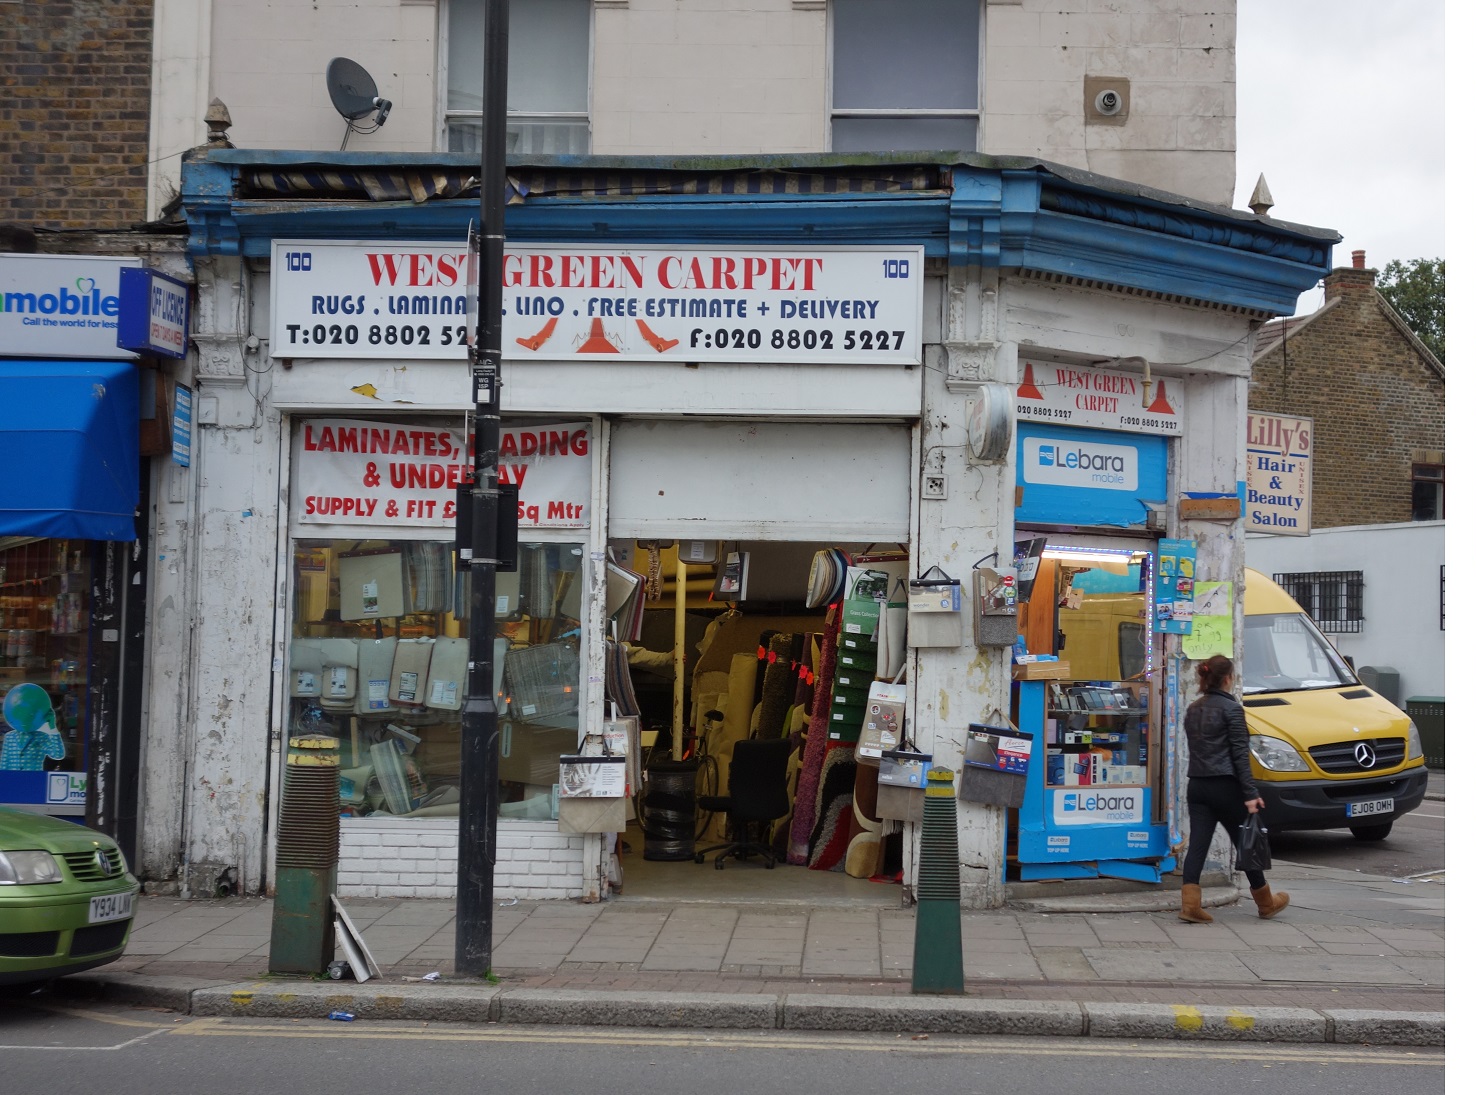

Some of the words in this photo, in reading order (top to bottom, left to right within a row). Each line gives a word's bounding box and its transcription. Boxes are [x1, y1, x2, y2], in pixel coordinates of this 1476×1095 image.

[285, 252, 312, 271] 100
[882, 259, 909, 279] 100
[502, 254, 647, 289] GREEN
[657, 256, 823, 290] CARPET
[0, 287, 119, 317] mobile
[312, 295, 365, 315] RUGS
[388, 295, 480, 316] LAMINA
[516, 296, 564, 316] LINO
[588, 297, 637, 317] FREE
[645, 298, 747, 318] ESTIMATE
[780, 300, 880, 319] DELIVERY
[23, 317, 40, 326] Call
[42, 317, 58, 327] the
[60, 318, 86, 328] world
[87, 319, 101, 328] for
[101, 320, 119, 329] less
[286, 324, 359, 345] T:020
[368, 324, 431, 345] 8802
[771, 328, 834, 350] 8802
[844, 330, 906, 351] 5227
[1056, 368, 1091, 389] WEST
[1094, 373, 1136, 395] GREEN
[1033, 407, 1052, 416] 8802
[1054, 409, 1072, 418] 5227
[1075, 393, 1119, 413] CARPET
[1142, 418, 1159, 428] 8802
[1161, 420, 1177, 429] 5227
[304, 425, 460, 460] LAMINATES,
[469, 429, 588, 457] ADING
[1247, 415, 1309, 457] Lilly's
[1056, 446, 1124, 473] Lebara
[1257, 456, 1296, 473] Hair
[363, 462, 380, 488] &
[1092, 473, 1124, 484] mobile
[1269, 475, 1282, 490] &
[305, 496, 378, 516] SUPPLY
[385, 500, 399, 518] &
[407, 500, 436, 519] FIT
[547, 501, 583, 520] Mtr
[1247, 489, 1304, 511] Beauty
[1252, 510, 1298, 527] Salon
[1078, 793, 1135, 812] Lebara
[1352, 802, 1375, 815] EJ08
[1107, 811, 1134, 820] mobile
[92, 896, 117, 918] Y934
